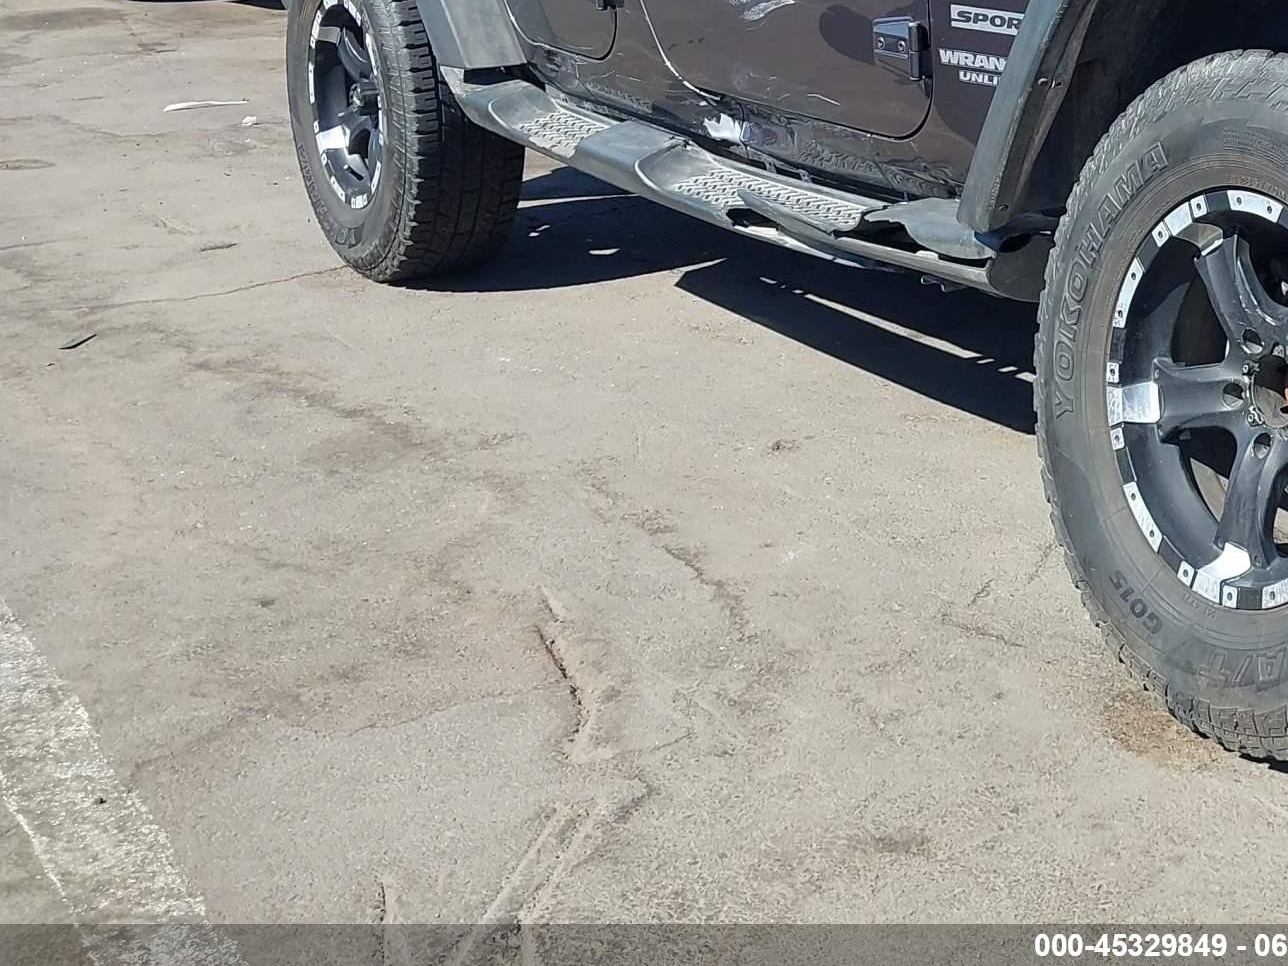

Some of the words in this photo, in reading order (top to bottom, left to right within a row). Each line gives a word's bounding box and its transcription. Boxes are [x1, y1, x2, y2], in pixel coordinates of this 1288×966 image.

[952, 10, 1022, 30] SPOR
[1053, 141, 1169, 419] YOKOHAMA
[1197, 646, 1288, 688] A/T
